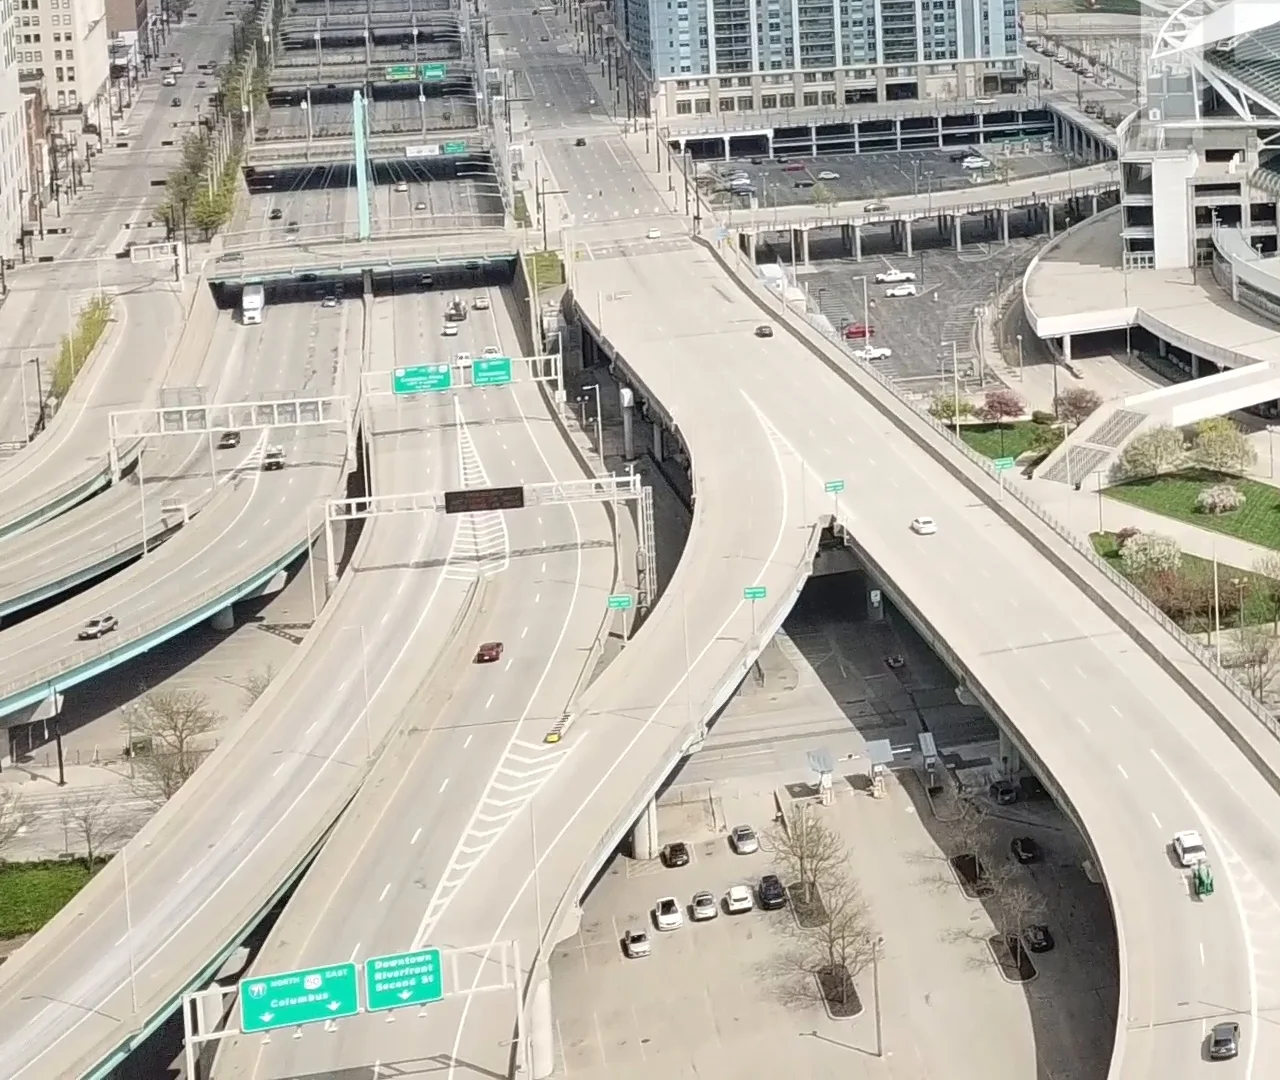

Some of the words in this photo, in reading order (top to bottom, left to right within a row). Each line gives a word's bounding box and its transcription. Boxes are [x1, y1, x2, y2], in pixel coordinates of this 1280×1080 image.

[374, 954, 432, 969] Downtown
[270, 977, 300, 987] NORTH
[325, 968, 348, 978] EAST
[374, 963, 434, 981] Riverfront
[375, 977, 416, 992] Second
[421, 974, 434, 984] St
[270, 991, 329, 1008] Columbus
